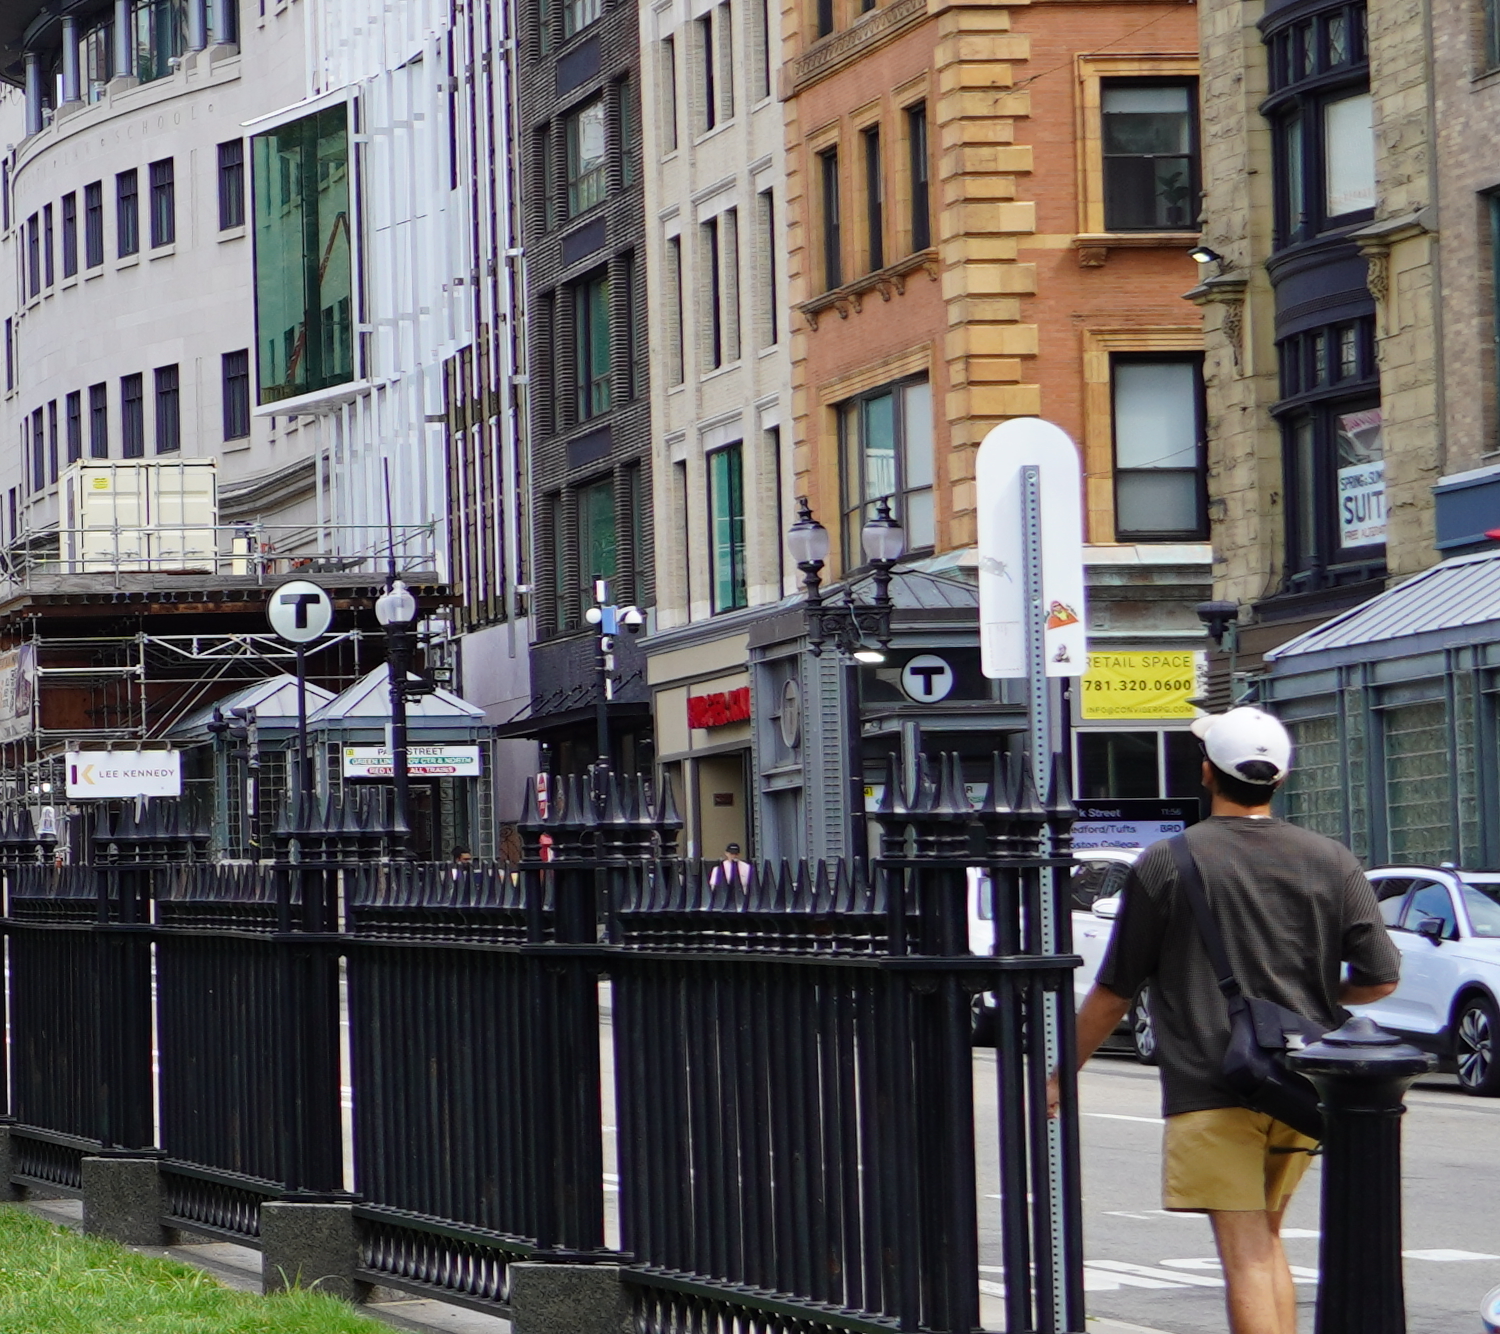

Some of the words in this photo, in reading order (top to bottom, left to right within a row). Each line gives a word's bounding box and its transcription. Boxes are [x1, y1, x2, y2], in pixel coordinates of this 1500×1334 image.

[114, 105, 197, 140] SCHOOL
[279, 593, 321, 629] T
[1142, 656, 1191, 668] SPACE
[909, 665, 945, 696] T
[1083, 679, 1192, 692] 781.320.0600
[407, 747, 445, 756] STREET
[380, 757, 394, 765] LIN
[99, 769, 119, 778] LEE
[123, 769, 175, 778] KENNEDY
[1088, 808, 1121, 818] Street
[1071, 824, 1137, 834] edford/Tufts
[1159, 824, 1182, 833] BRD
[1069, 841, 1099, 849] oston
